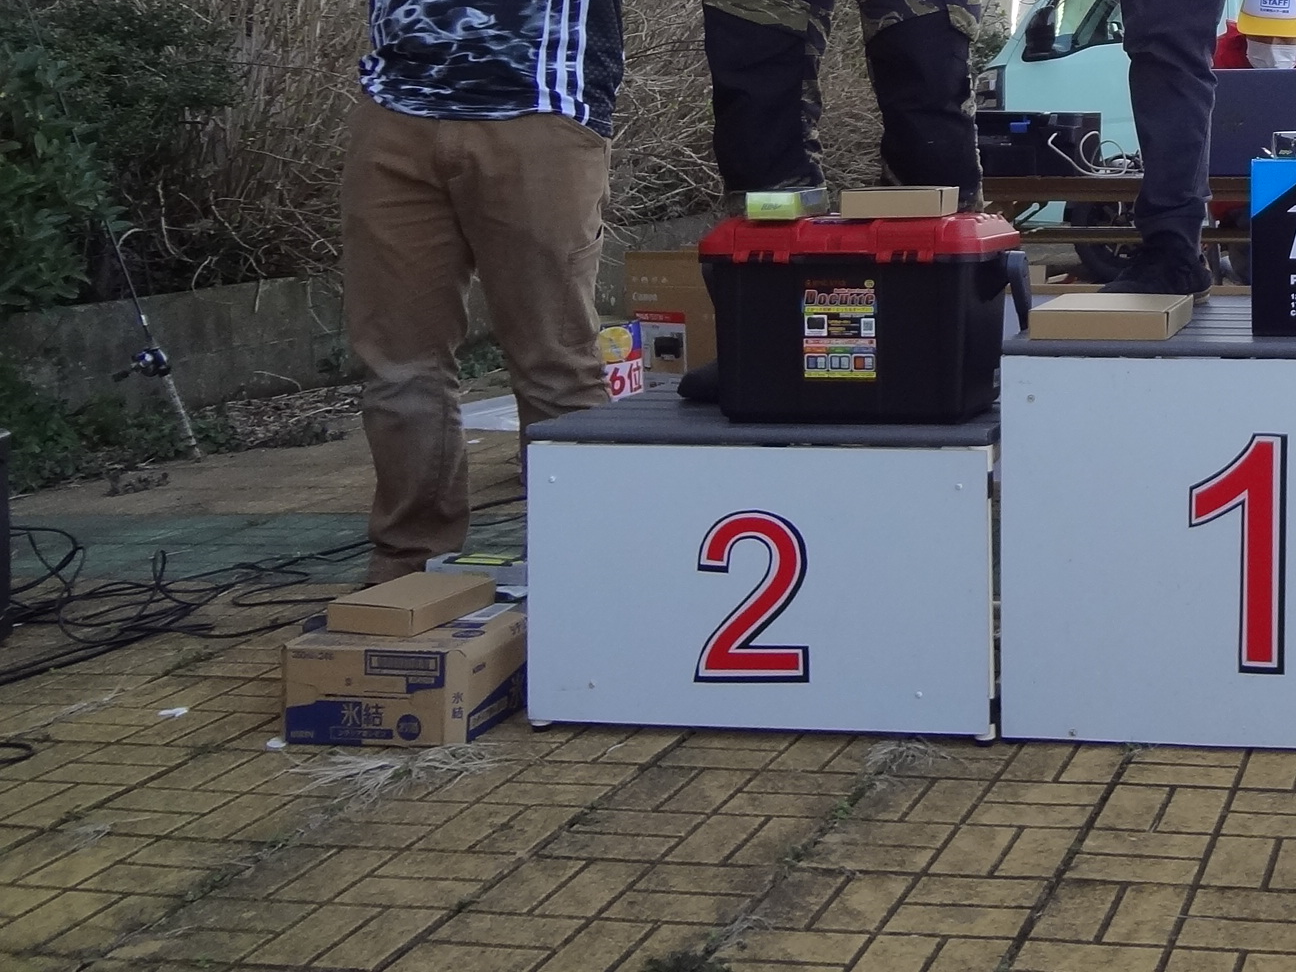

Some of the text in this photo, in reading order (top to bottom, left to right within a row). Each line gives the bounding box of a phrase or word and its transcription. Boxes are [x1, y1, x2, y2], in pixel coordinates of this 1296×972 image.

[608, 361, 643, 397] 6位
[694, 509, 811, 686] 2
[1186, 432, 1289, 675] 1
[341, 702, 387, 726] 氷結
